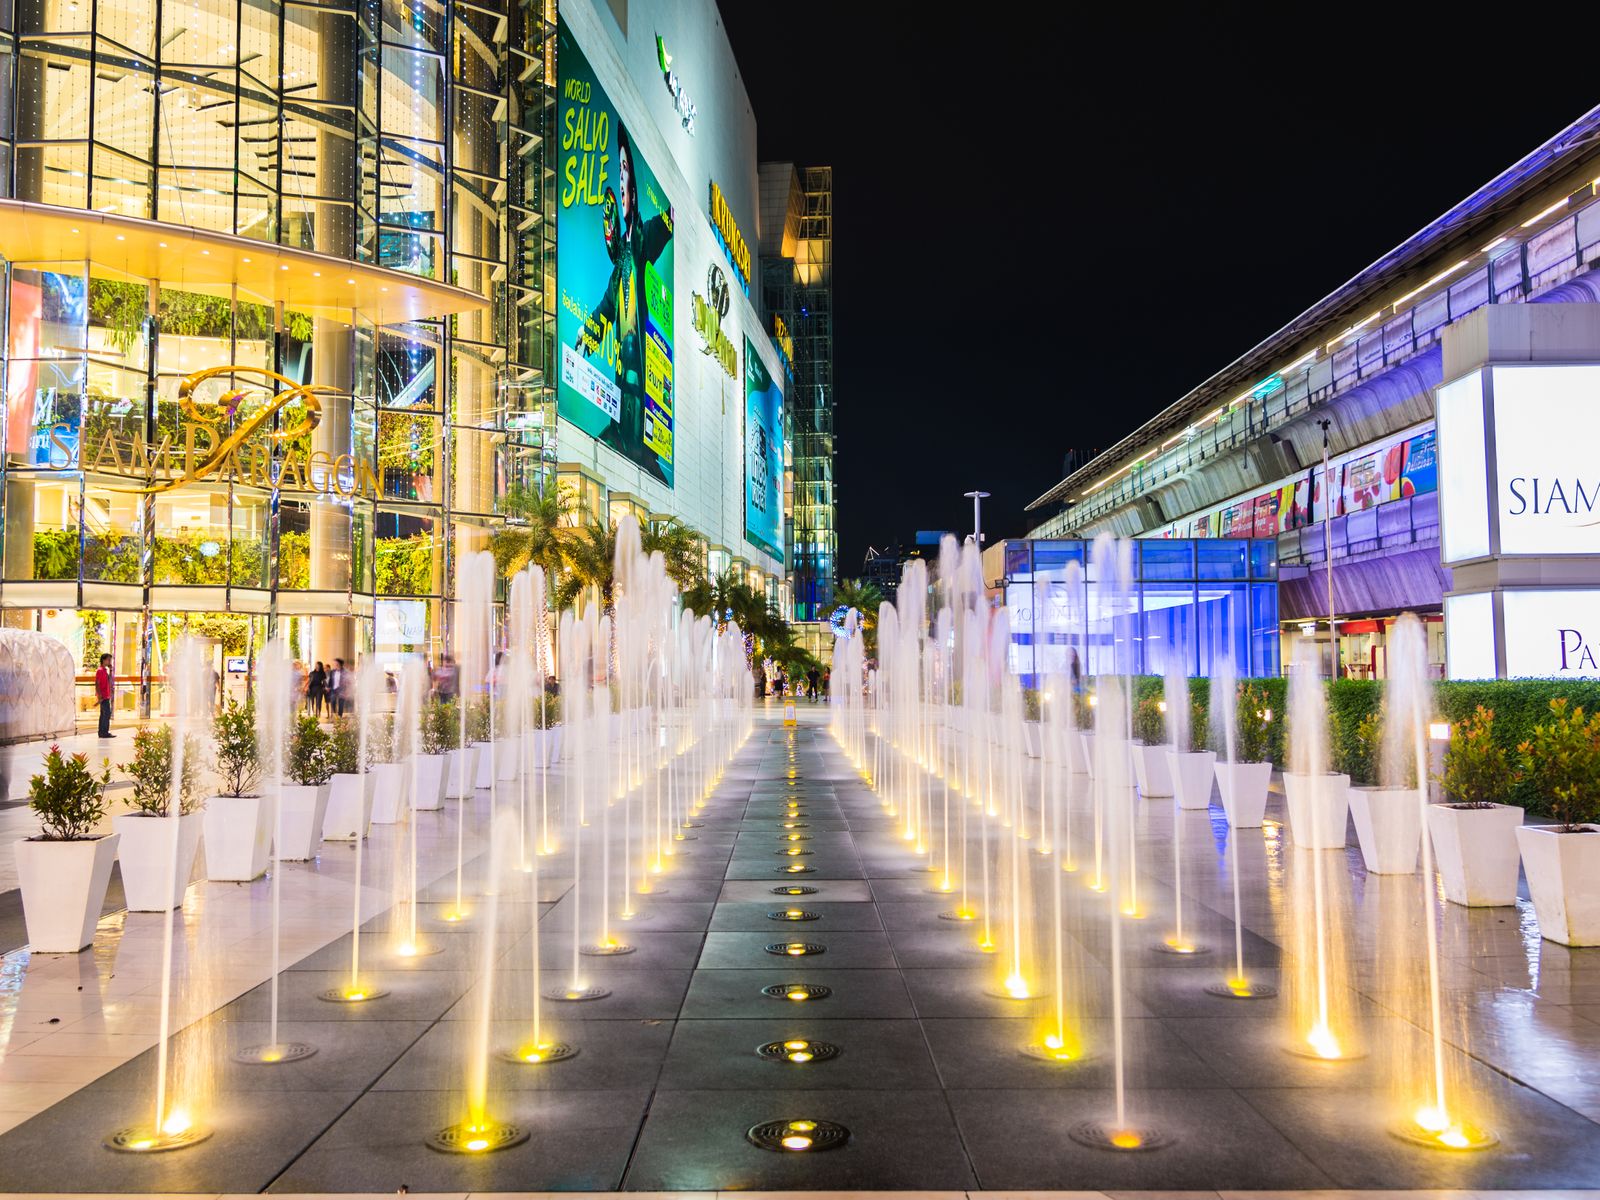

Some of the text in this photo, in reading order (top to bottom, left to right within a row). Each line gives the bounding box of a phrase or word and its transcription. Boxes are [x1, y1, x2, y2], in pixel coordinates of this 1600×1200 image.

[564, 78, 591, 104] WORLD
[562, 108, 609, 153] SALVO
[562, 153, 610, 208] SALE
[49, 421, 385, 500] SIAM PARAGON
[1509, 477, 1600, 516] SIAM
[1557, 629, 1600, 671] PA
